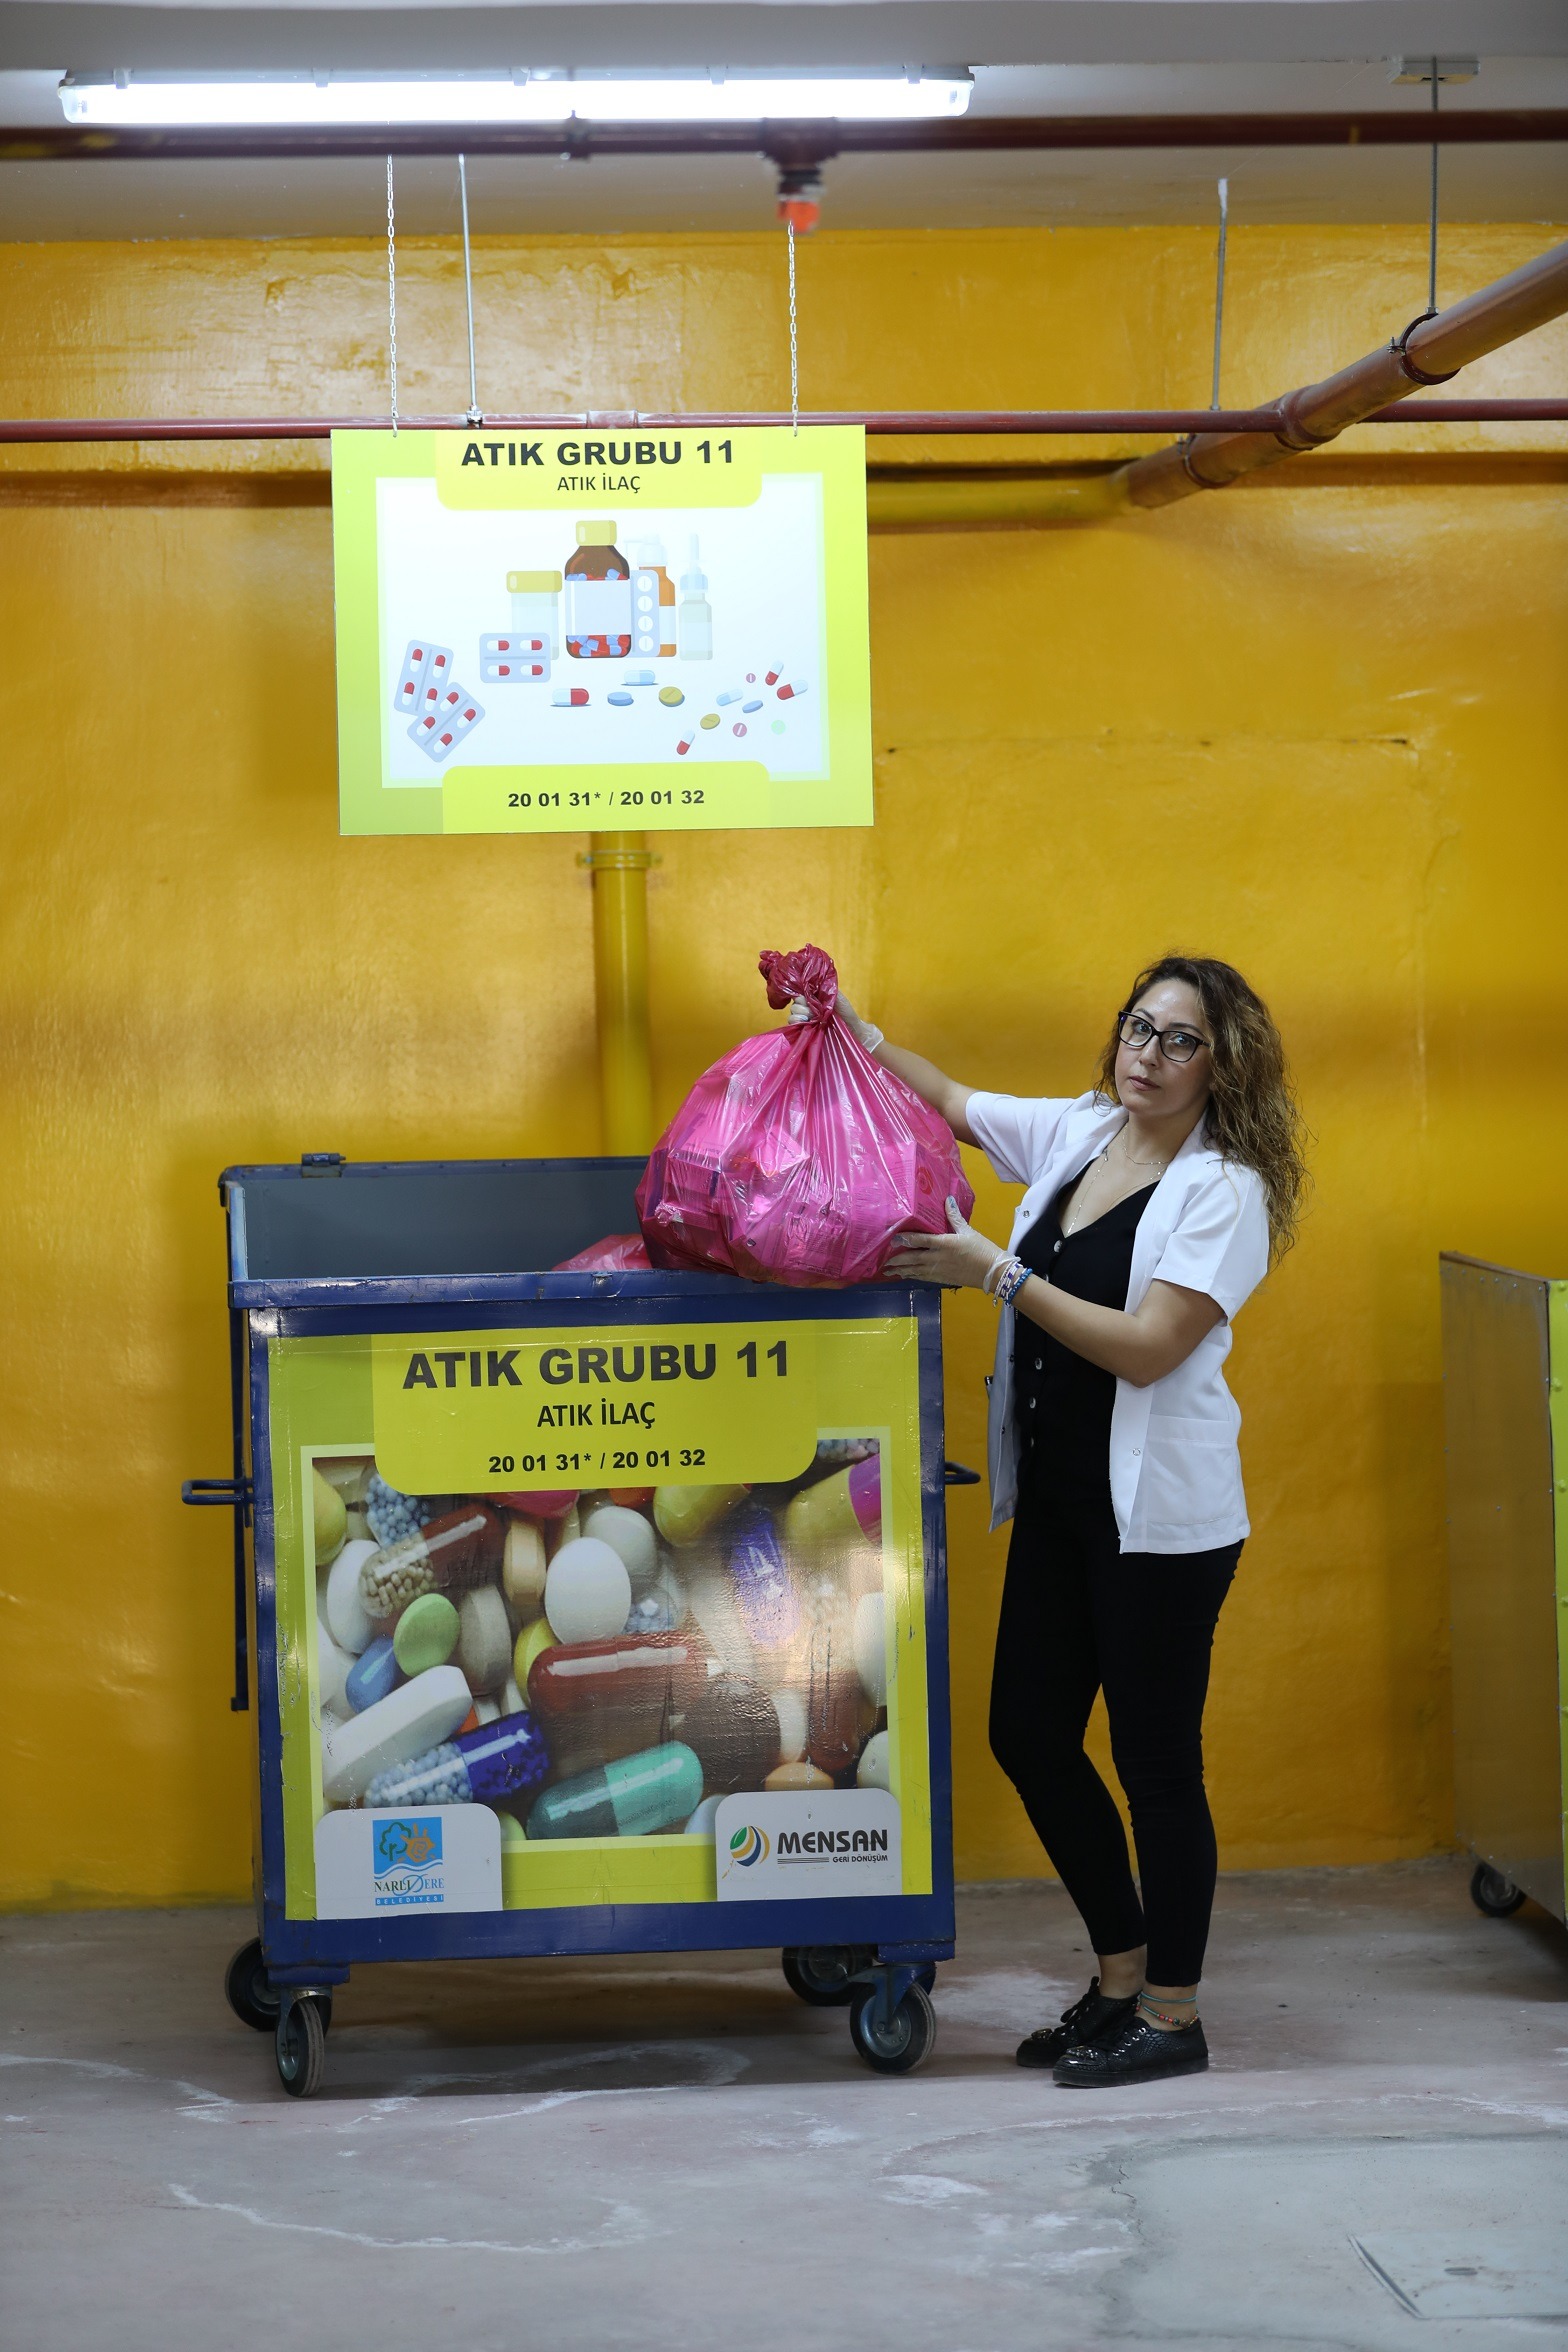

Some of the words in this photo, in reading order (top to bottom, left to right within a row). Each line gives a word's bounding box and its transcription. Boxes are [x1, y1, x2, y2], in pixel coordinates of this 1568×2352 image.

[461, 442, 545, 467] ATIK
[556, 441, 682, 466] GRUBU
[696, 439, 732, 464] 11
[557, 476, 597, 491] ATIK
[602, 472, 641, 494] İLAÇ
[508, 792, 532, 808] 20
[538, 792, 560, 807] 01
[608, 791, 614, 806] /
[620, 791, 644, 806] 20
[650, 790, 672, 805] 01
[681, 789, 705, 805] 32
[402, 1349, 523, 1390] ATIK
[539, 1343, 717, 1386] GRUBU
[736, 1340, 788, 1378] 11
[536, 1403, 594, 1428] ATIK
[601, 1397, 656, 1430] İLAÇ
[488, 1455, 515, 1473] 20
[522, 1454, 546, 1472] 01
[599, 1452, 606, 1470] /
[612, 1451, 639, 1469] 20
[645, 1449, 670, 1468] 01
[679, 1448, 706, 1467] 32
[777, 1829, 888, 1854] MENSAN
[851, 1852, 889, 1864] DÖNÜŞÜM
